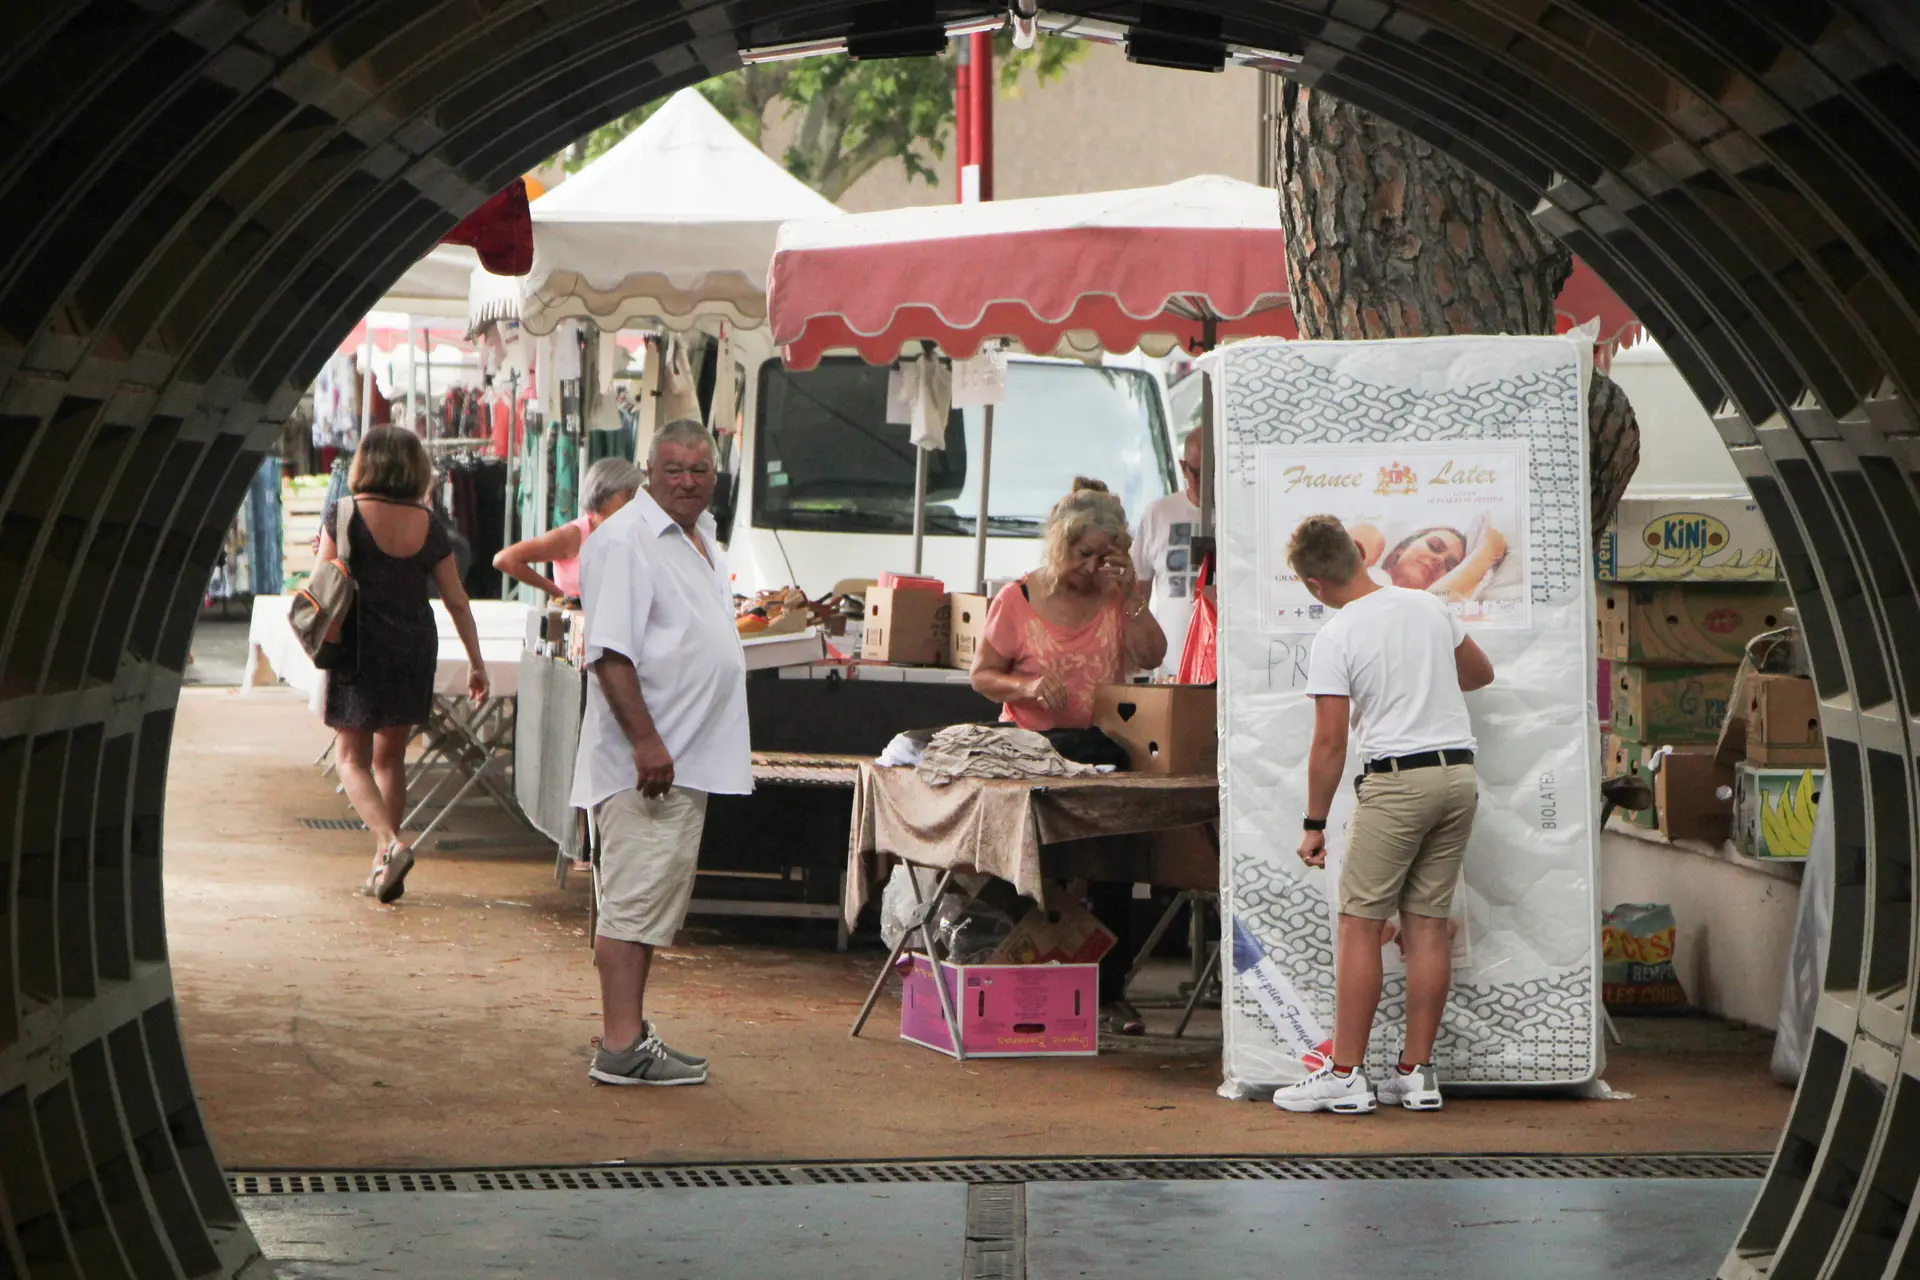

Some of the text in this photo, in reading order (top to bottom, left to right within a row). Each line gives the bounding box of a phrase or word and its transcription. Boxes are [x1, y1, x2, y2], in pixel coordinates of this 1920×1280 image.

[1282, 460, 1497, 494] France Latex
[1267, 639, 1309, 688] PR
[1540, 769, 1557, 829] BIOLATEX
[1252, 963, 1319, 1051] onception Françai
